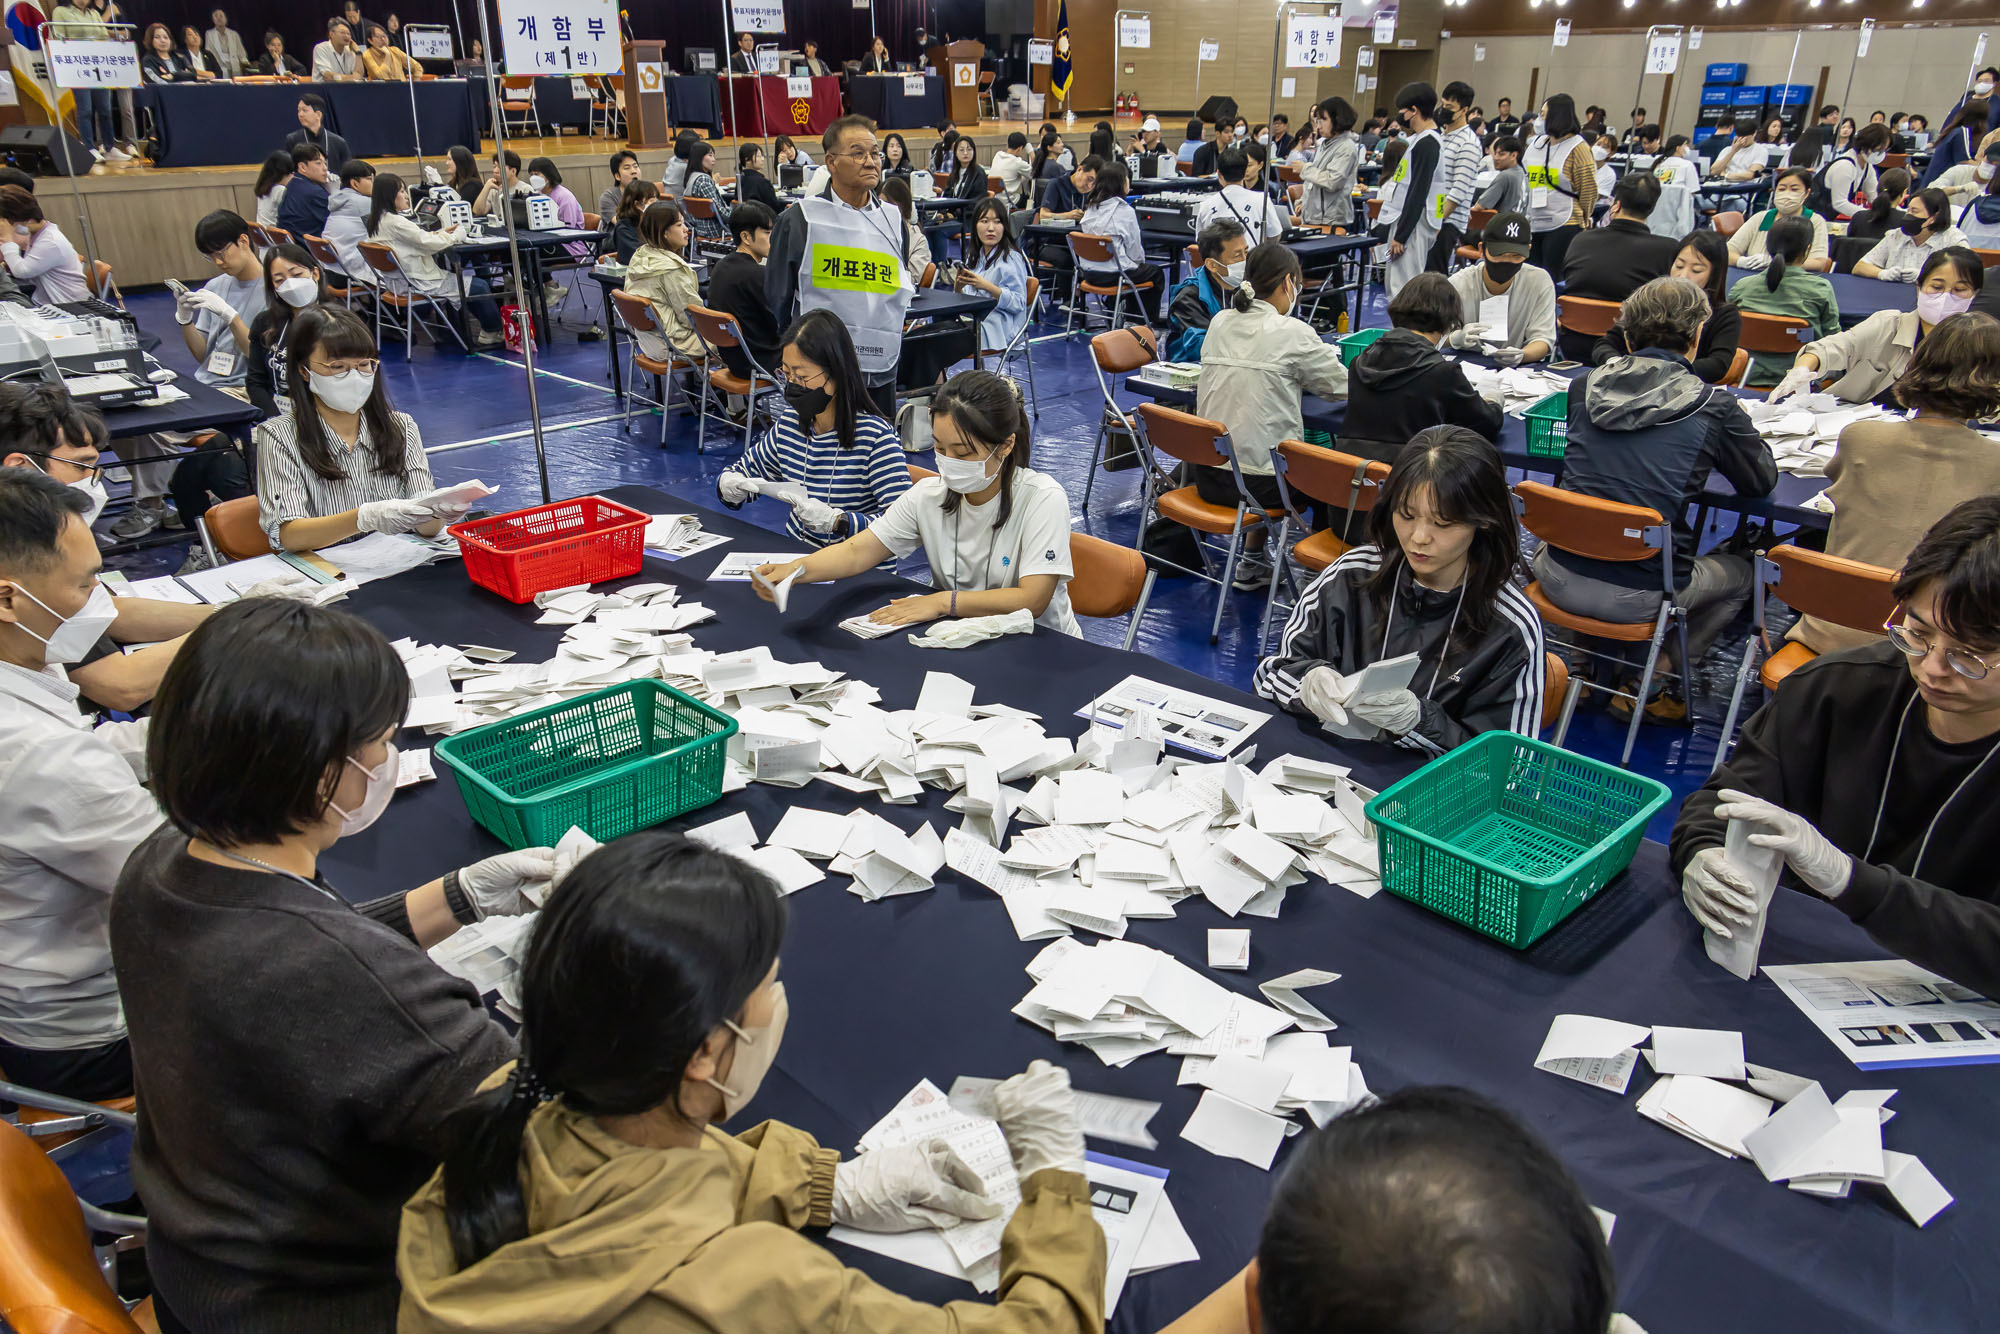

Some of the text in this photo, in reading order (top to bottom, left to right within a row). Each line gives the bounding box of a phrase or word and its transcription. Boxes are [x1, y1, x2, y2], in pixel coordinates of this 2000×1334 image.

[54, 54, 136, 66] 투표지분류기운영부
[1505, 222, 1520, 237] NY
[822, 257, 892, 284] 개표참관
